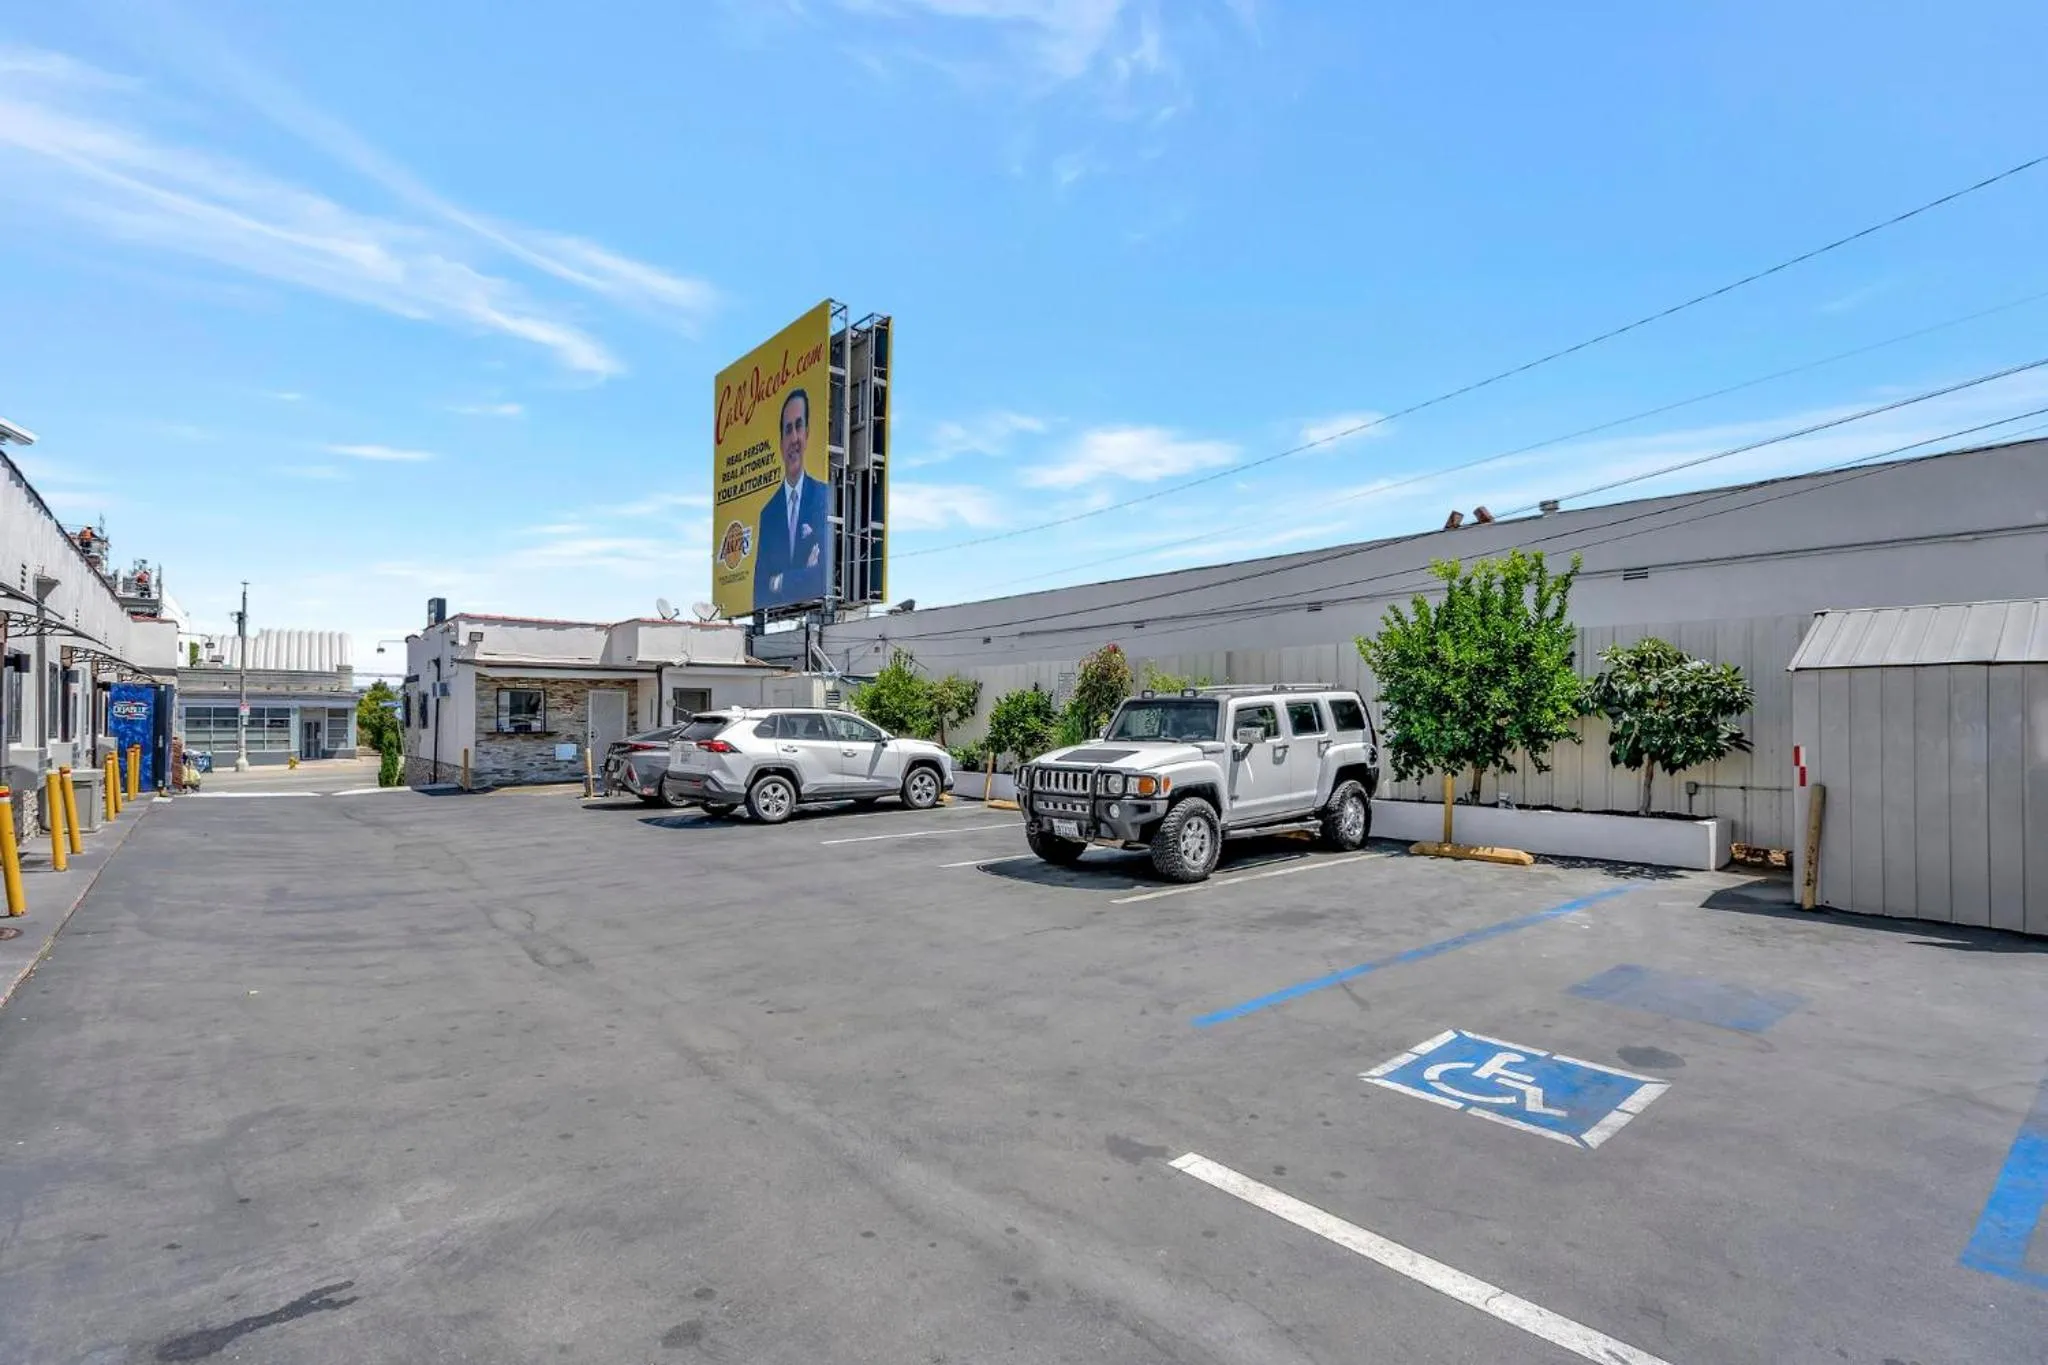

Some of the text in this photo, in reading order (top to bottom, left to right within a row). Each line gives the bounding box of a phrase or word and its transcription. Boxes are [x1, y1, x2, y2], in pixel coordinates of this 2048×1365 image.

[726, 452, 743, 467] REAL
[722, 468, 738, 483] REAL
[717, 484, 738, 501] YOUR
